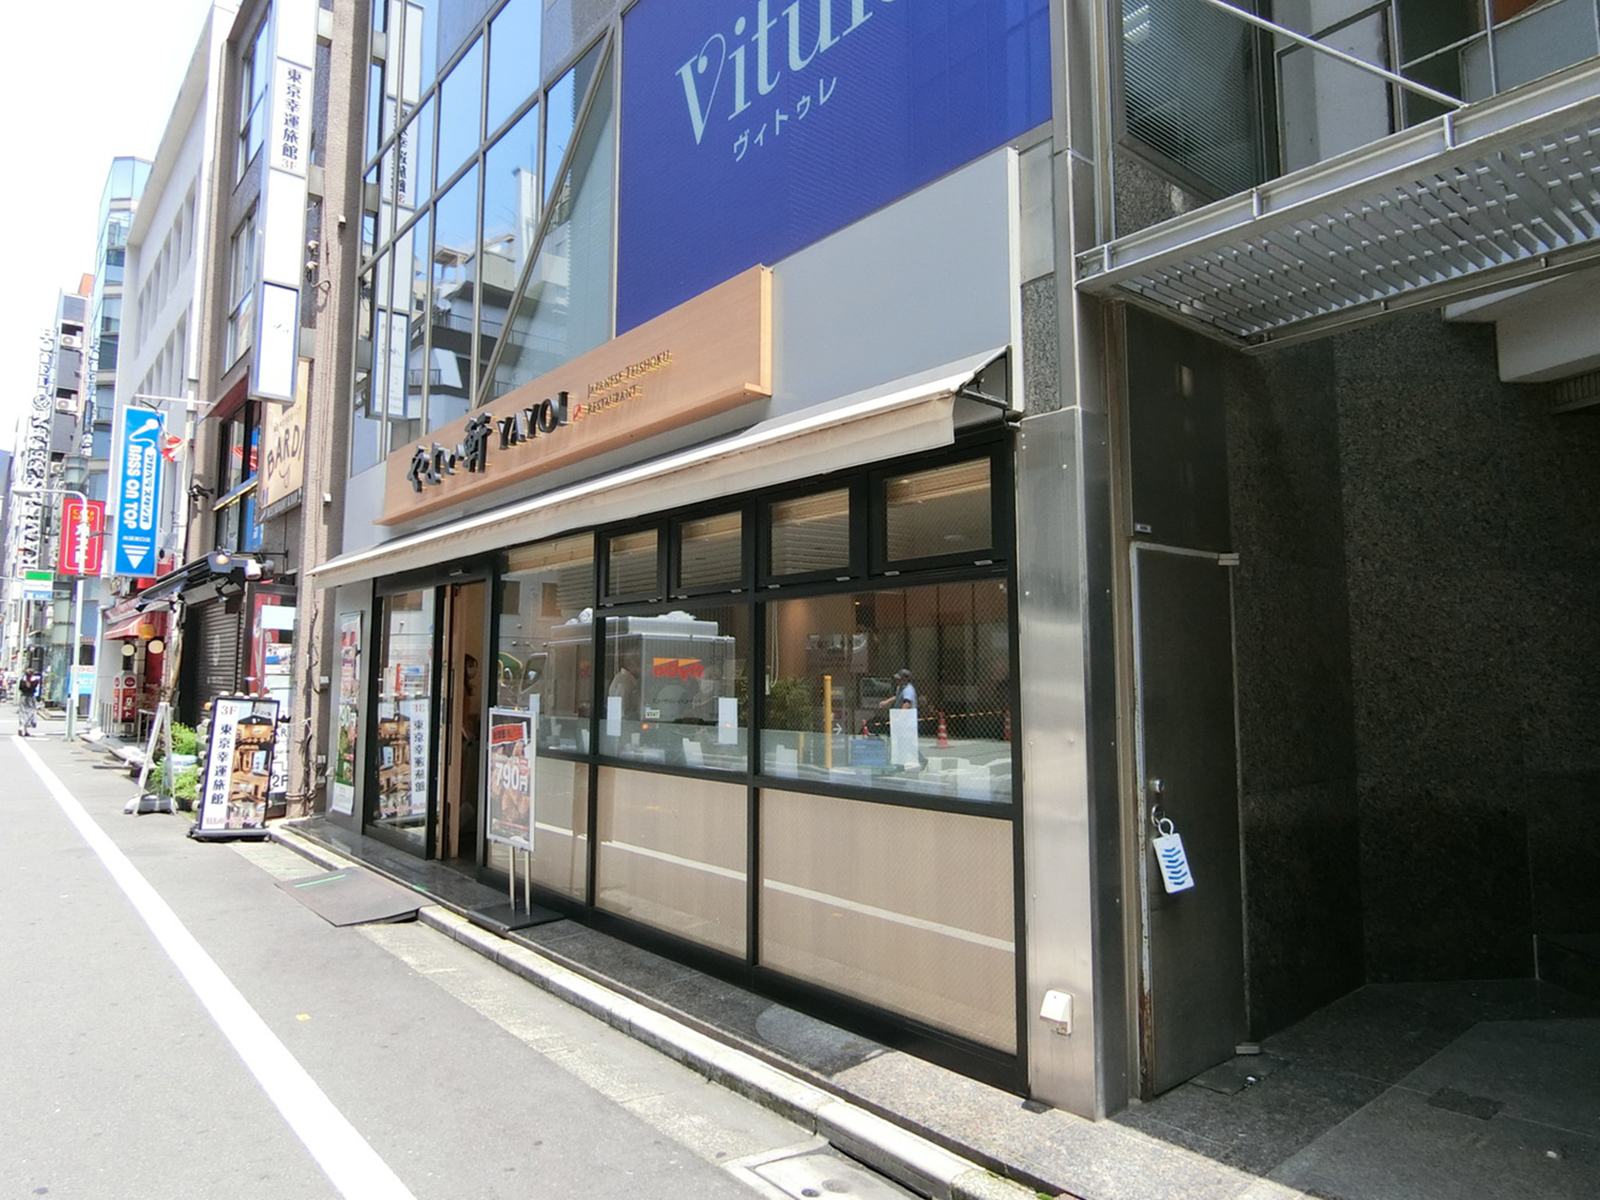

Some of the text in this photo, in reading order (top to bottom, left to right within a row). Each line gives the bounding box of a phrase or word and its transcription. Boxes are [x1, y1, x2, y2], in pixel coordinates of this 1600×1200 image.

[282, 67, 302, 160] 東京幸運旅館
[733, 77, 837, 162] ヴィトゥレ
[587, 385, 641, 415] RESTAURANT
[127, 445, 142, 477] BASS
[407, 391, 570, 493] やよい軒 YAYOI
[123, 501, 138, 530] TOP
[220, 705, 237, 716] 3F
[211, 724, 232, 805] 東京幸運旅館
